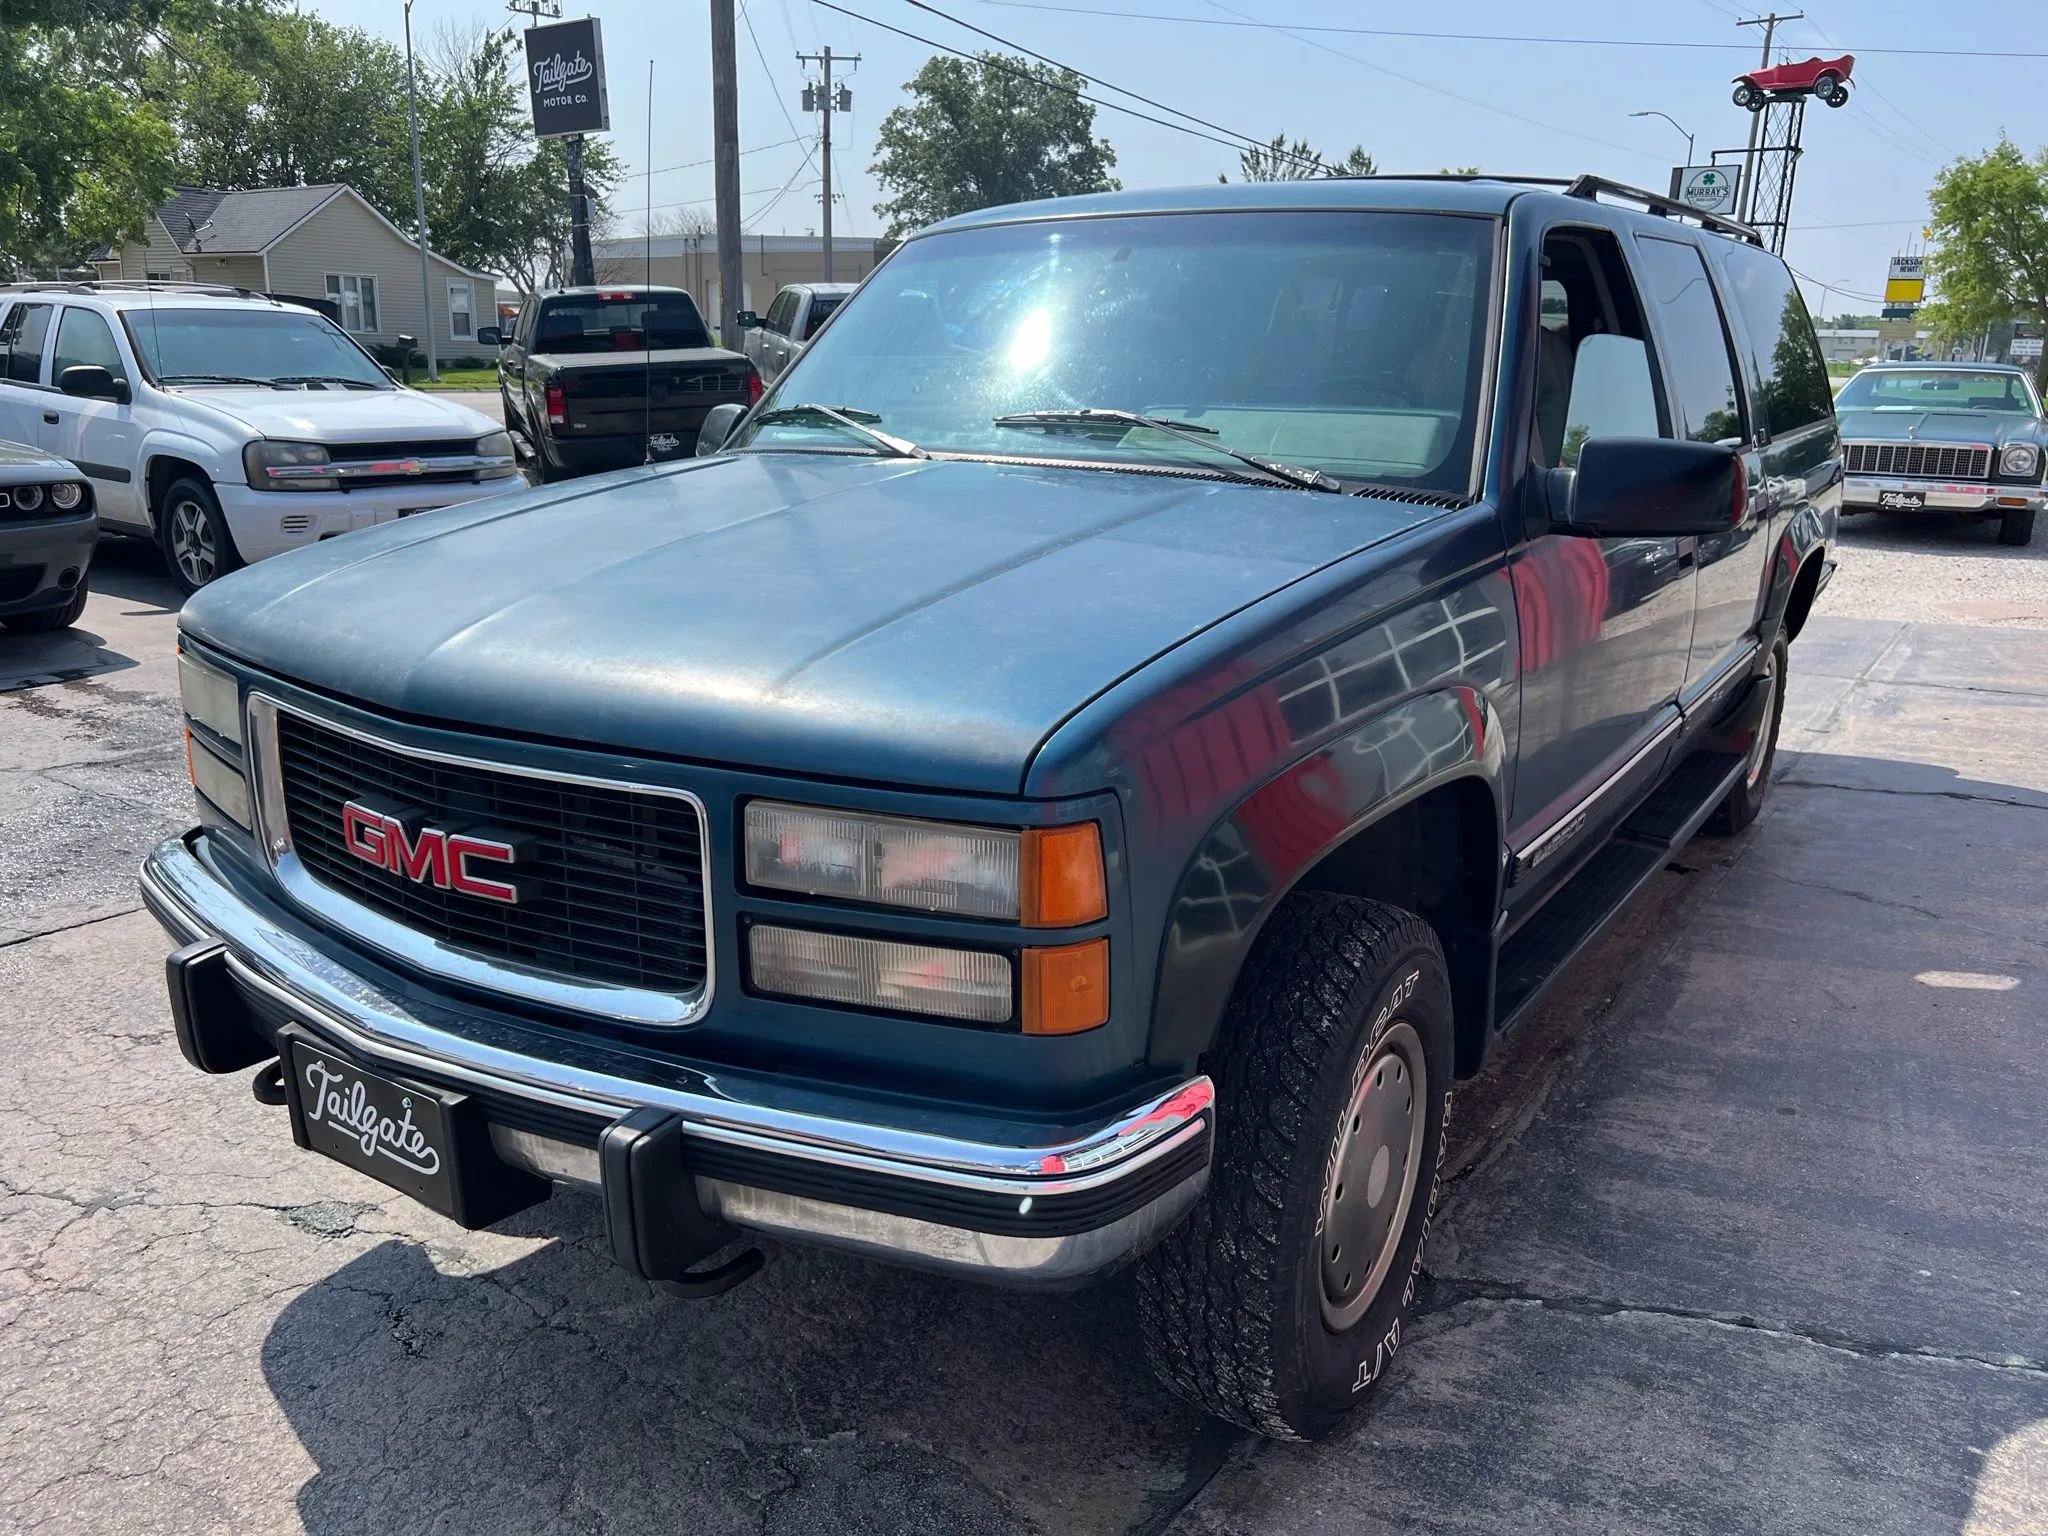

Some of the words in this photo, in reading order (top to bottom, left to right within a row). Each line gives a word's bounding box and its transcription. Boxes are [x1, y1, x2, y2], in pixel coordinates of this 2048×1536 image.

[534, 50, 593, 93] Tailgate
[544, 96, 573, 108] MOTOR
[1687, 187, 1729, 197] MURRAY'S
[1880, 493, 1922, 508] Tailgate
[342, 800, 518, 904] GMC
[305, 1061, 441, 1176] Tailgate
[1402, 1091, 1453, 1308] RADIAL
[1352, 1317, 1401, 1393] A/T
